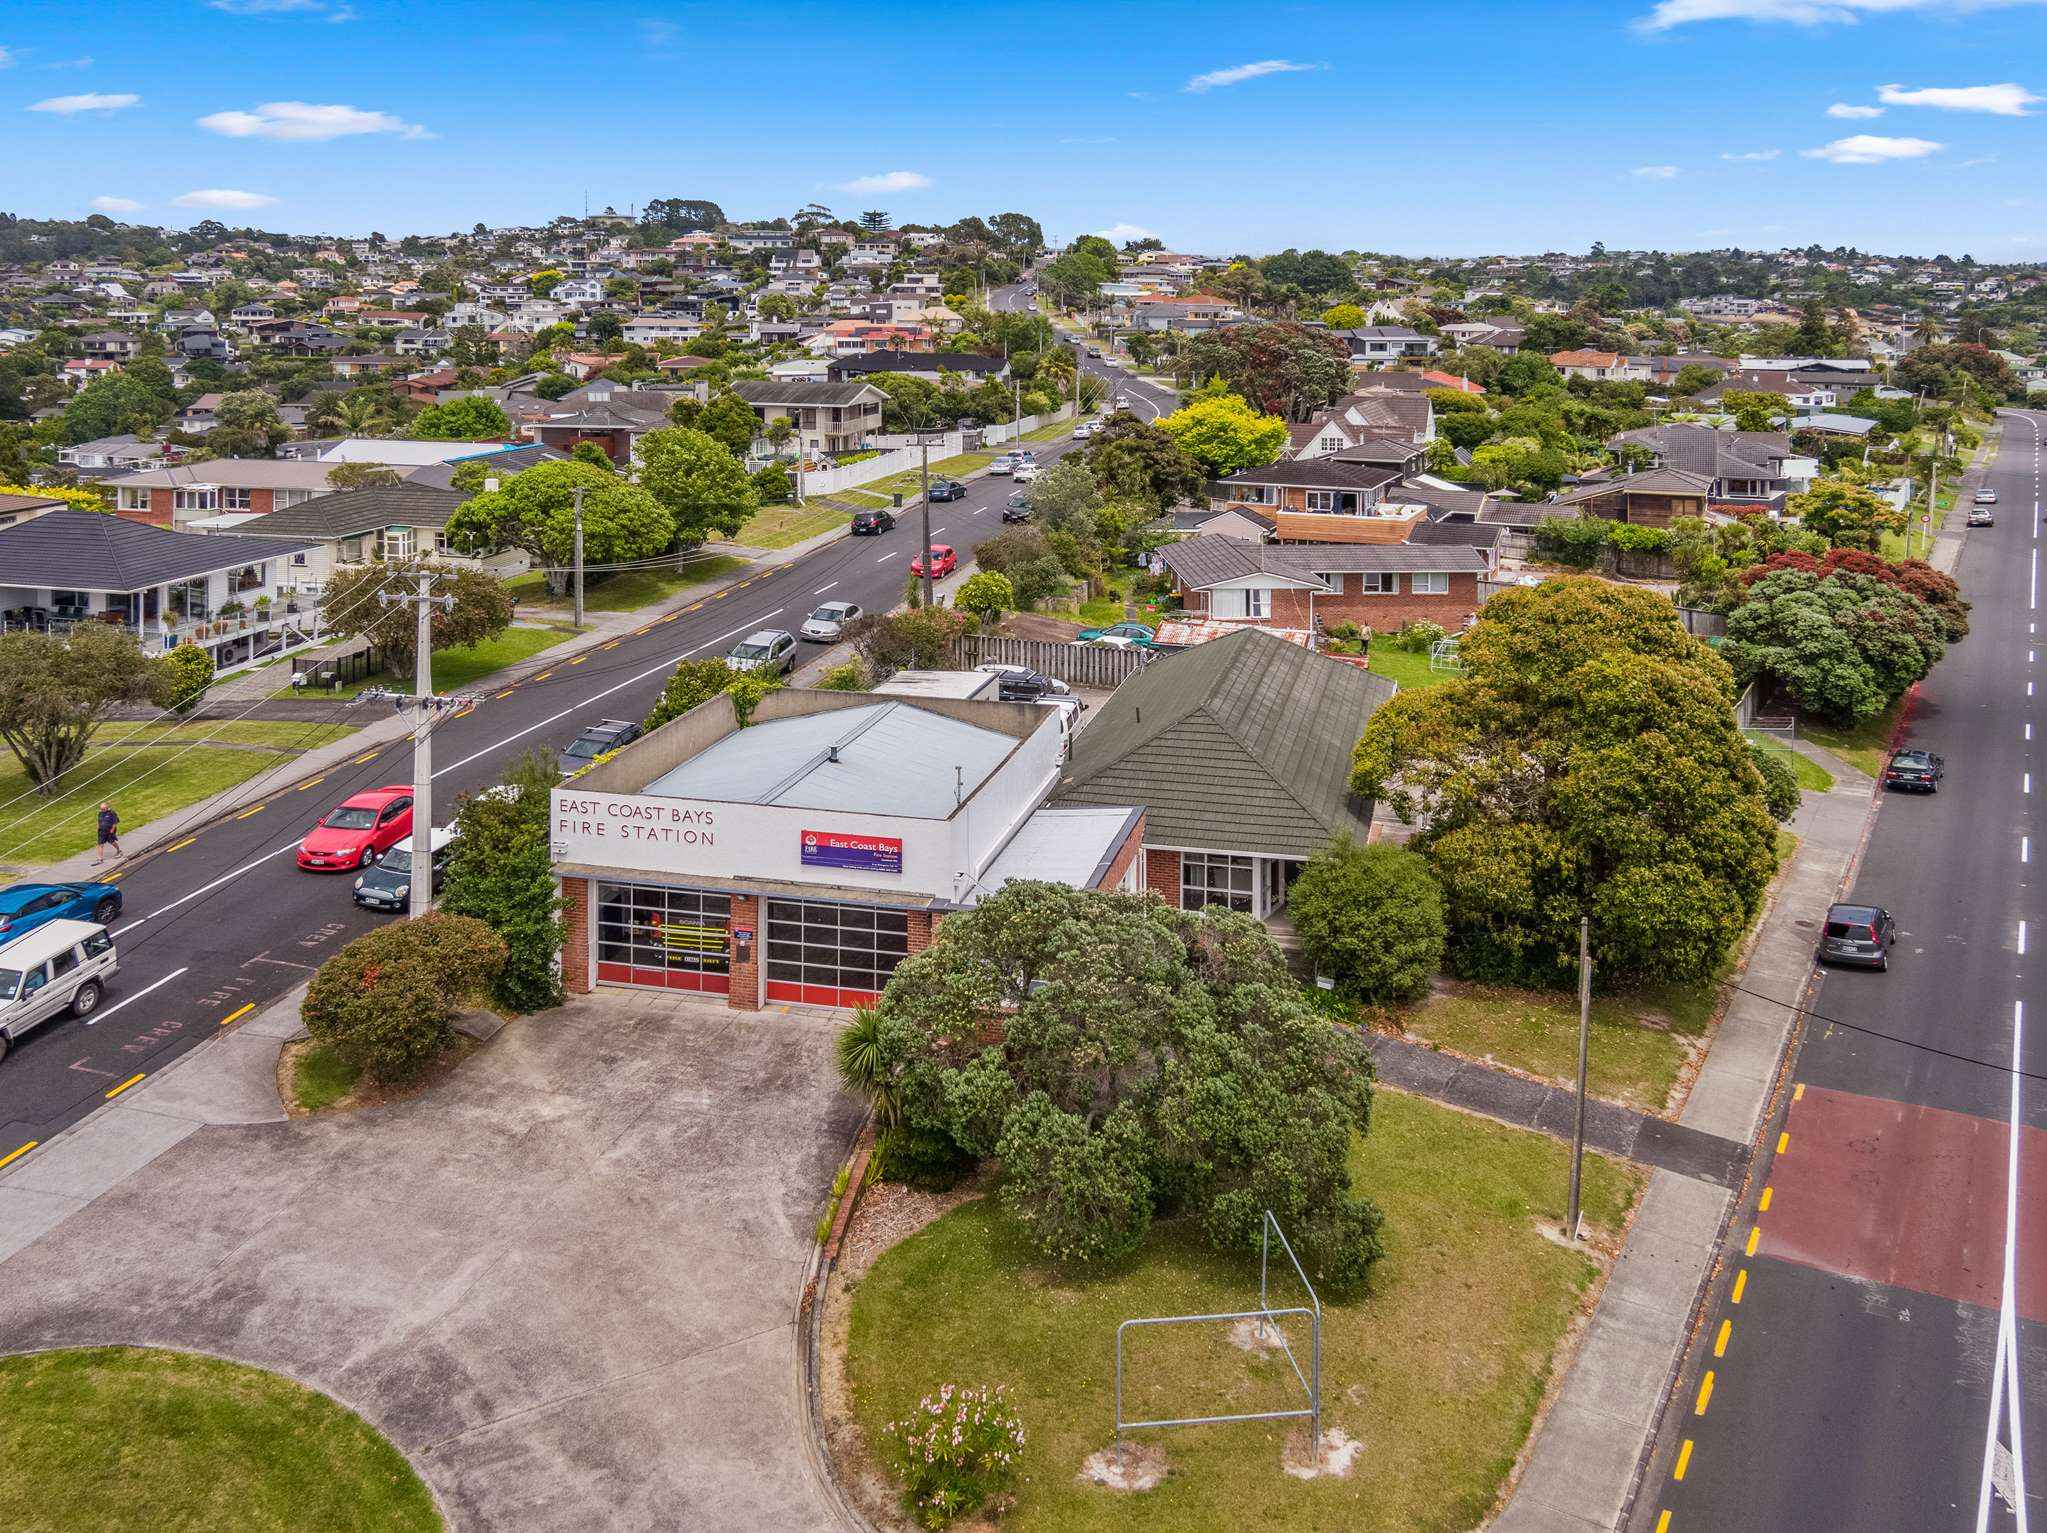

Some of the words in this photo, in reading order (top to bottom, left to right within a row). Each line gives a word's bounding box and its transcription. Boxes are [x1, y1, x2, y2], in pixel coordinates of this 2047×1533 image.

[559, 799, 601, 815] EAST
[607, 803, 665, 821] COAST
[671, 808, 714, 825] BAYS
[559, 819, 606, 836] FIRE
[621, 824, 714, 846] STATION
[830, 839, 848, 848] East
[850, 841, 877, 851] Coast
[879, 843, 898, 854] Bays
